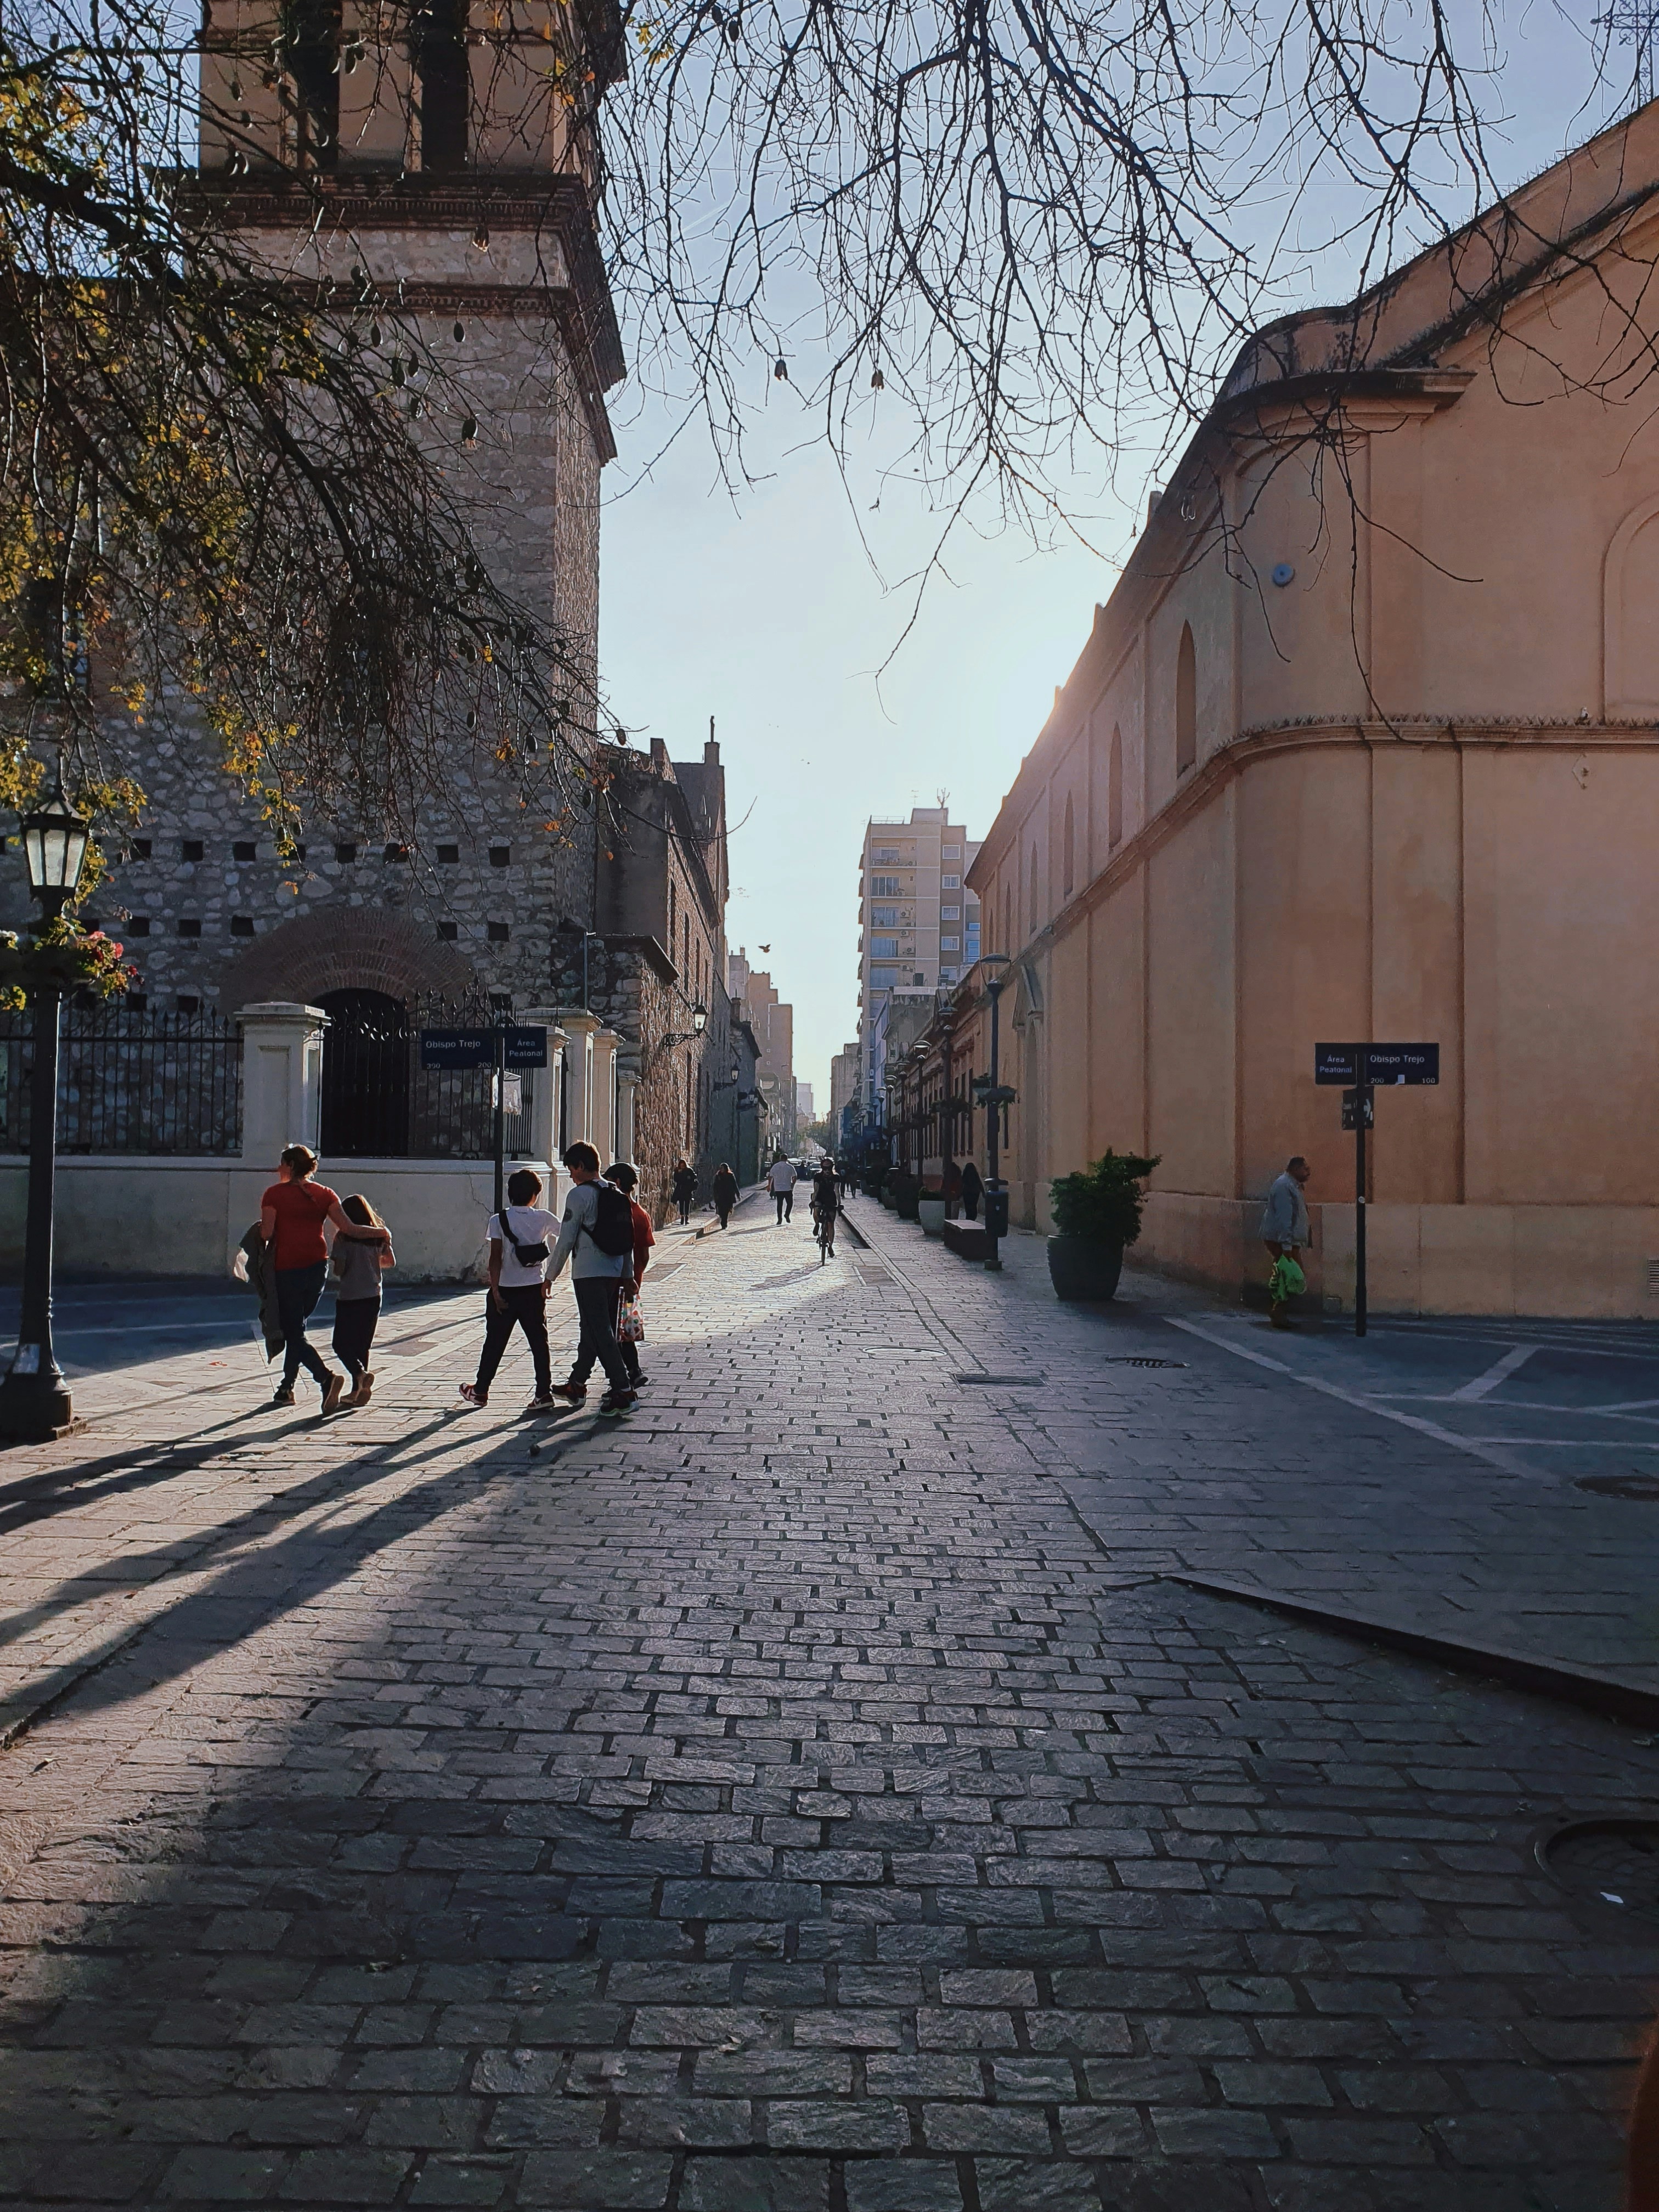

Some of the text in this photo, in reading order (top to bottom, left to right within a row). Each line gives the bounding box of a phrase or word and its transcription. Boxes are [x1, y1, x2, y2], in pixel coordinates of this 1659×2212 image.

[426, 1040, 481, 1049] Obispo Trejo
[517, 1039, 535, 1047] Área
[1370, 1054, 1425, 1064] Obispo Trejo
